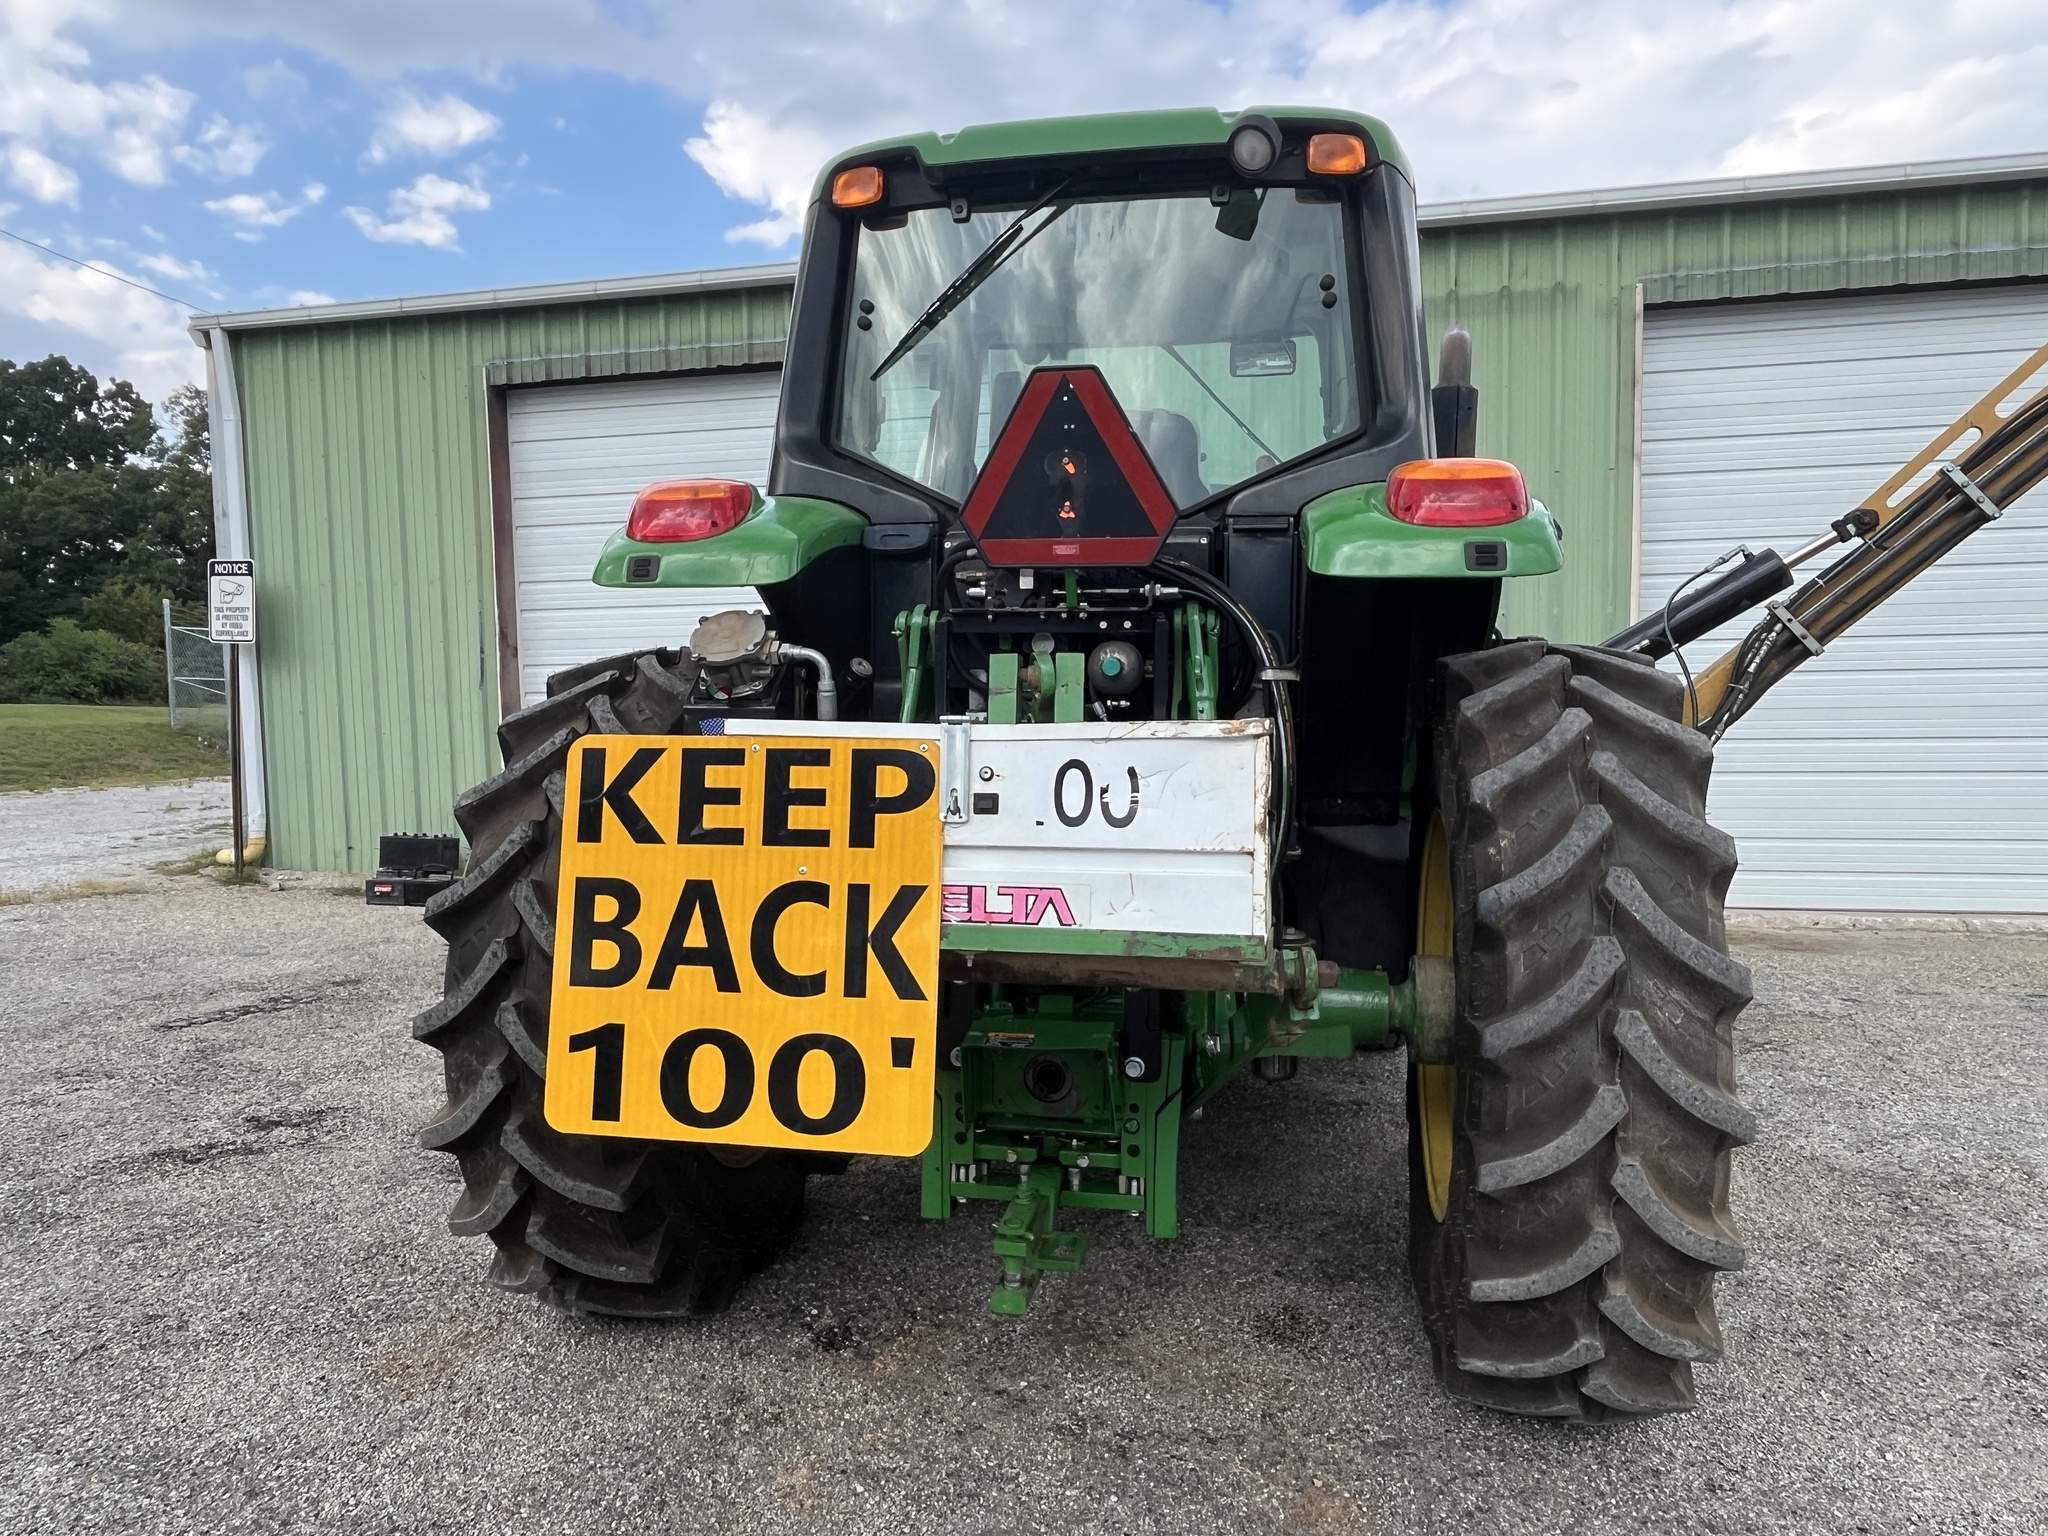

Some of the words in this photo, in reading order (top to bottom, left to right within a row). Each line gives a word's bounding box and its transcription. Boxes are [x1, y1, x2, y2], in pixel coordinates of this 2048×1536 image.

[214, 563, 249, 574] NOTICE
[577, 747, 936, 848] KEEP
[569, 876, 929, 1001] BACK
[569, 1023, 915, 1135] 100'
